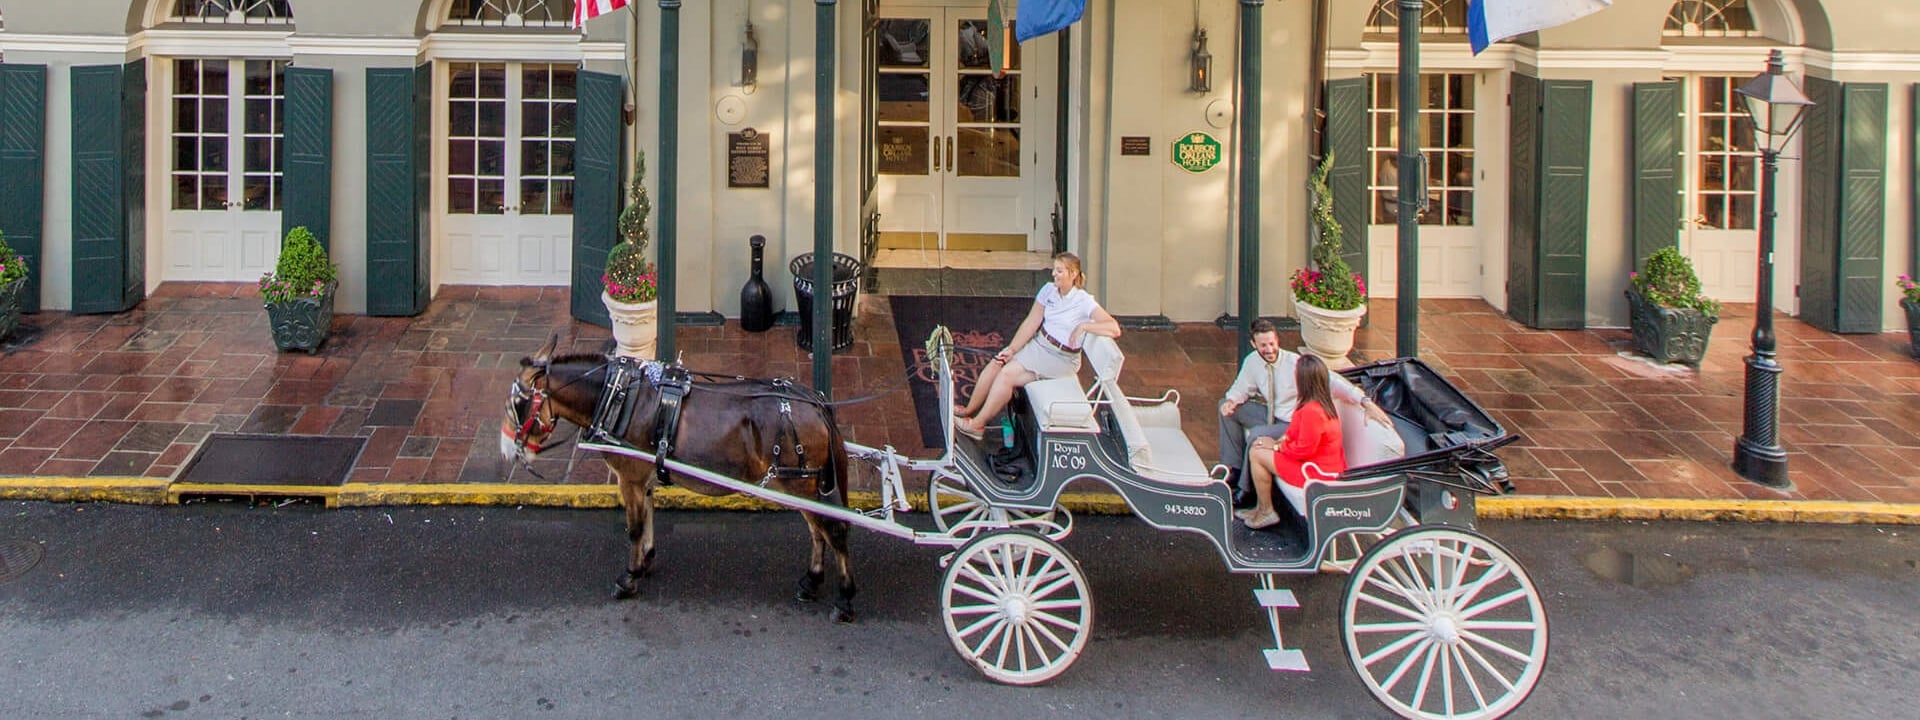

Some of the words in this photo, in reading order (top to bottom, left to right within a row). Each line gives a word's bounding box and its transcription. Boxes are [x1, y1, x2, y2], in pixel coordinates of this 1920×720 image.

[1182, 158, 1211, 166] HOTEL
[1054, 443, 1081, 456] Royal
[1051, 454, 1069, 469] AC
[1070, 455, 1087, 470] 09
[1164, 503, 1207, 517] 943-8820
